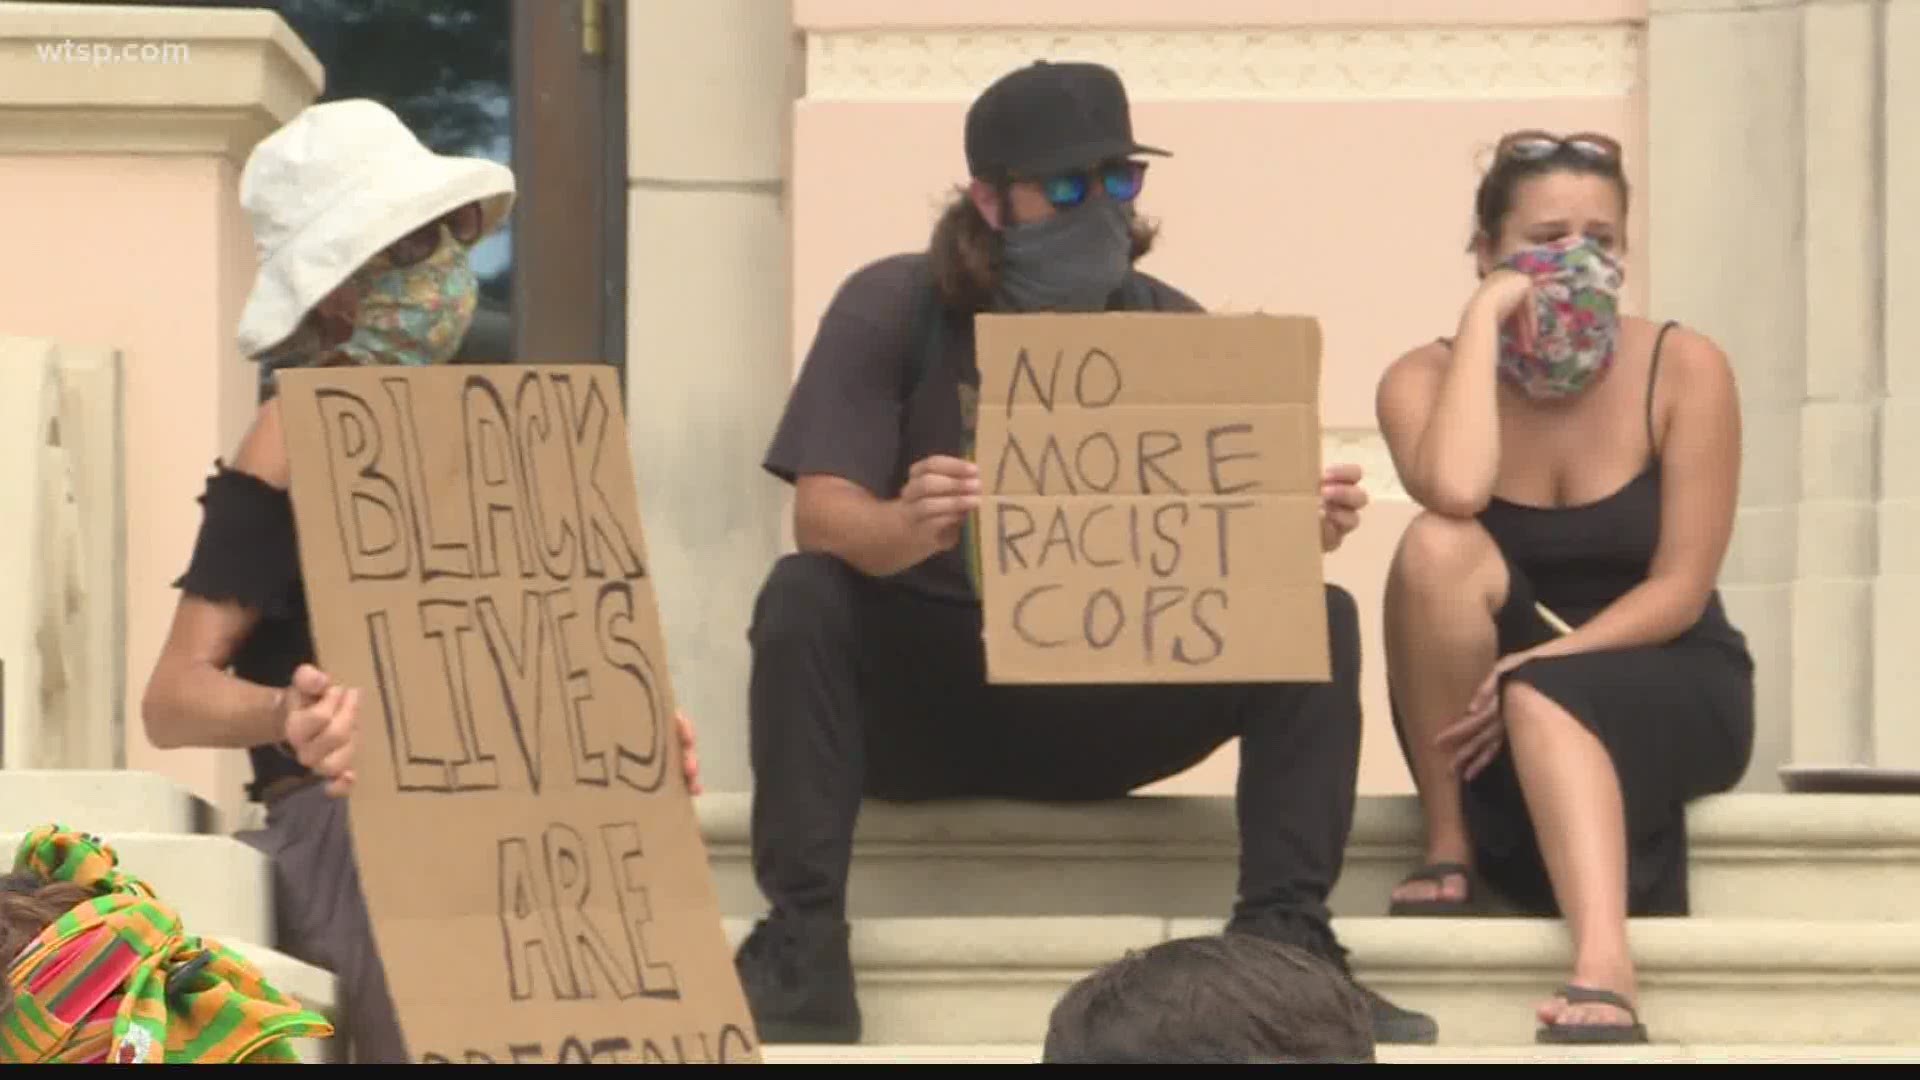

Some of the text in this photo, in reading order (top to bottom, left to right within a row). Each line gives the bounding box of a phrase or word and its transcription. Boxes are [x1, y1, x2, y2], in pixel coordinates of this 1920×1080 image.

[1005, 347, 1122, 420] NO
[315, 371, 646, 582] BLACK
[993, 424, 1262, 496] MORE
[996, 502, 1255, 578] RACIST
[1012, 584, 1229, 666] COPS
[366, 581, 668, 795] LIVES
[498, 821, 682, 1001] ARE
